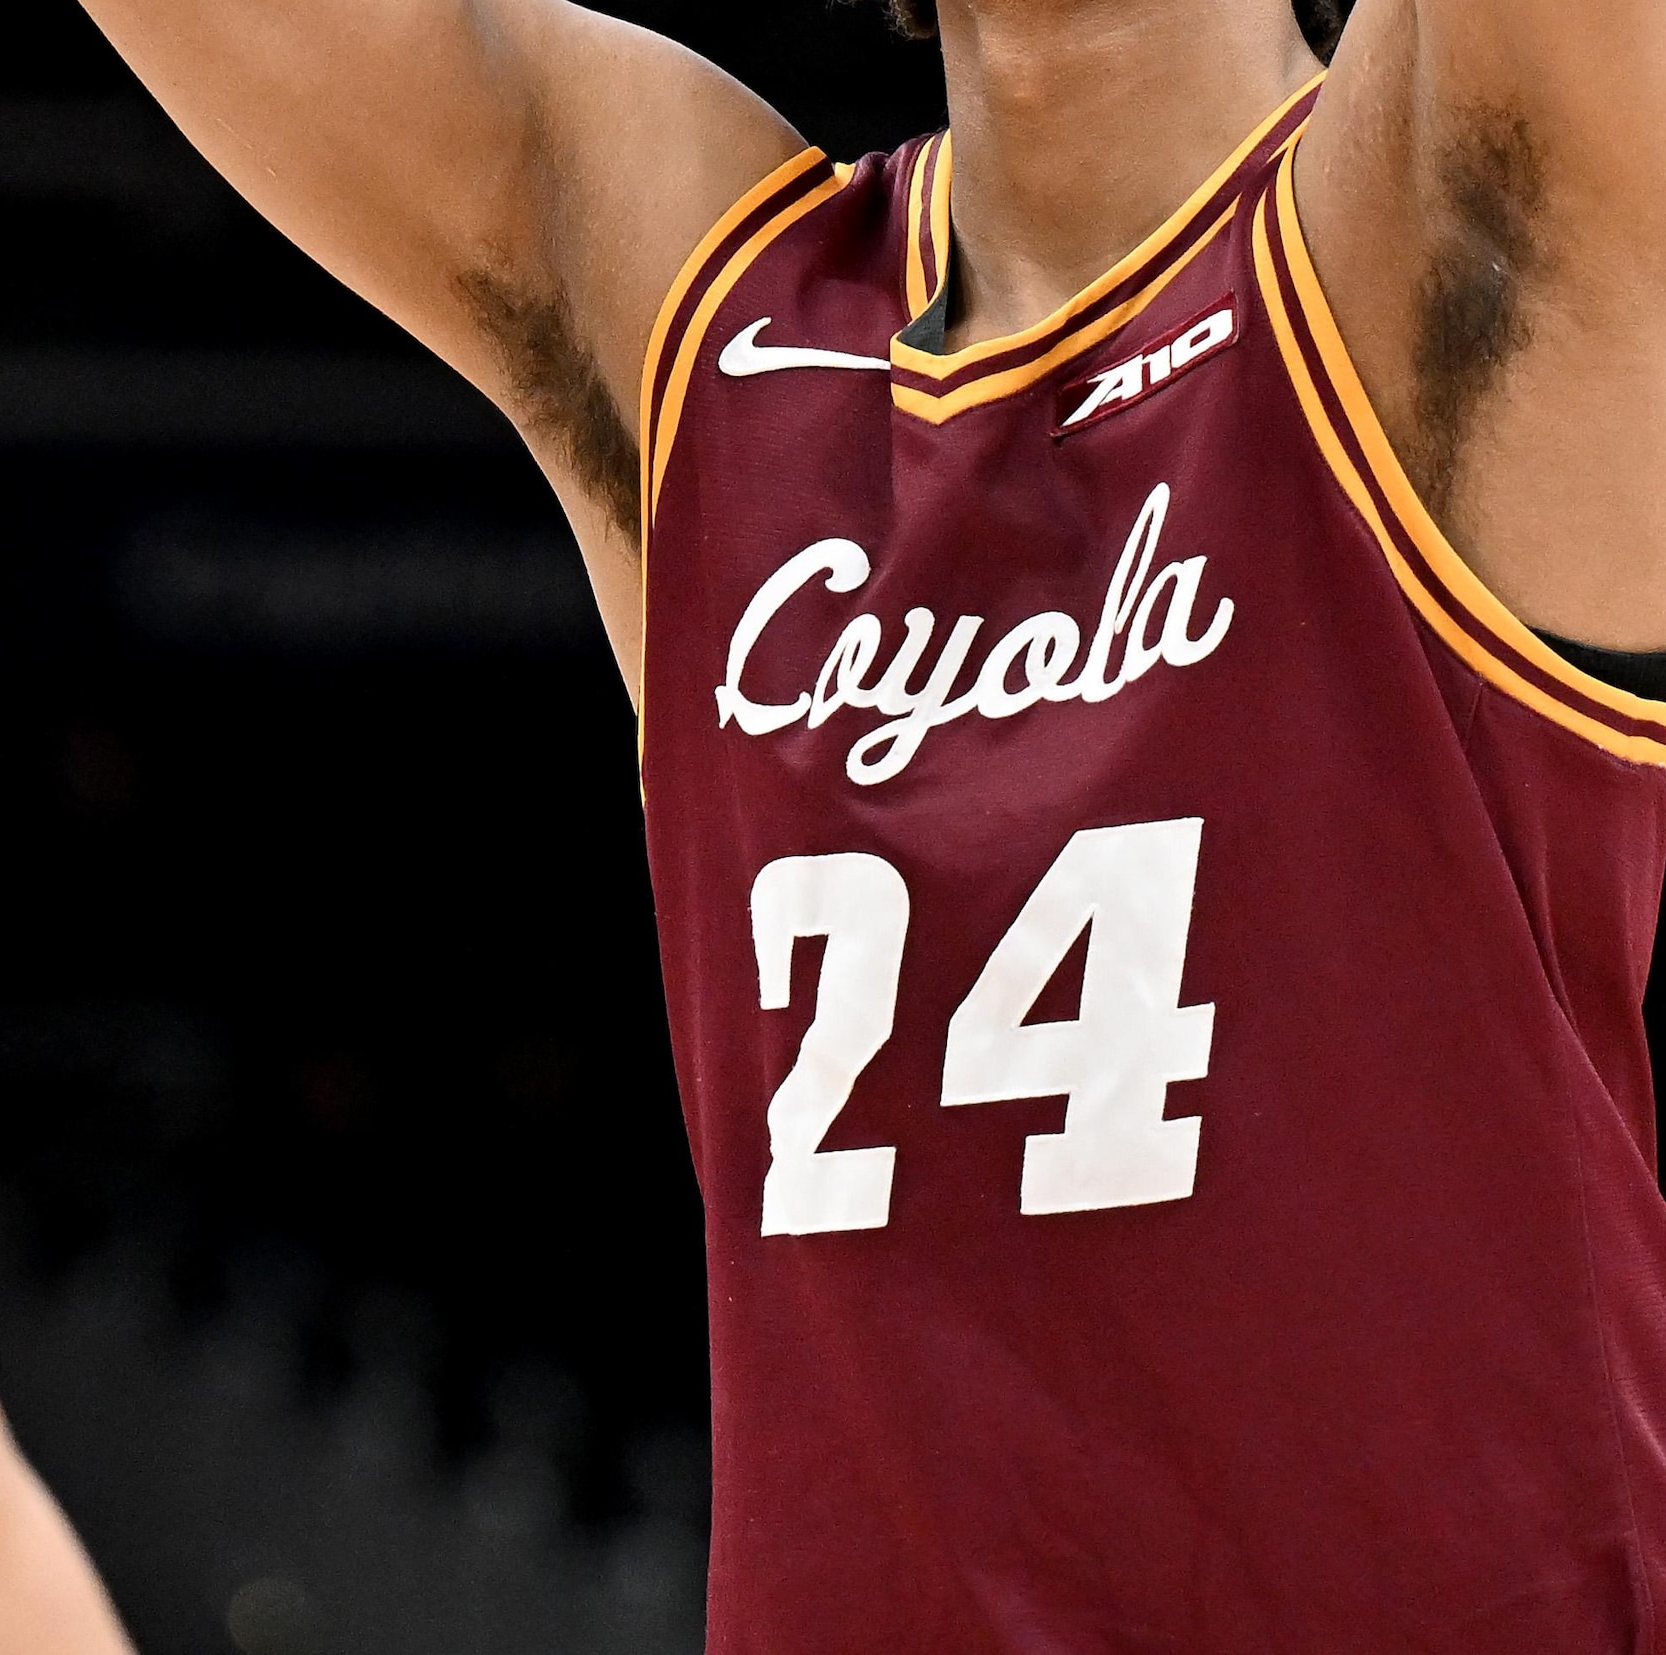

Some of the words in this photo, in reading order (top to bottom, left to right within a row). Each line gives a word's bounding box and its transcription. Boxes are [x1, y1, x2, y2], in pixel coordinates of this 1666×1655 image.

[1062, 309, 1233, 427] A10
[714, 482, 1235, 786] Loyola
[749, 816, 1215, 1237] 24
